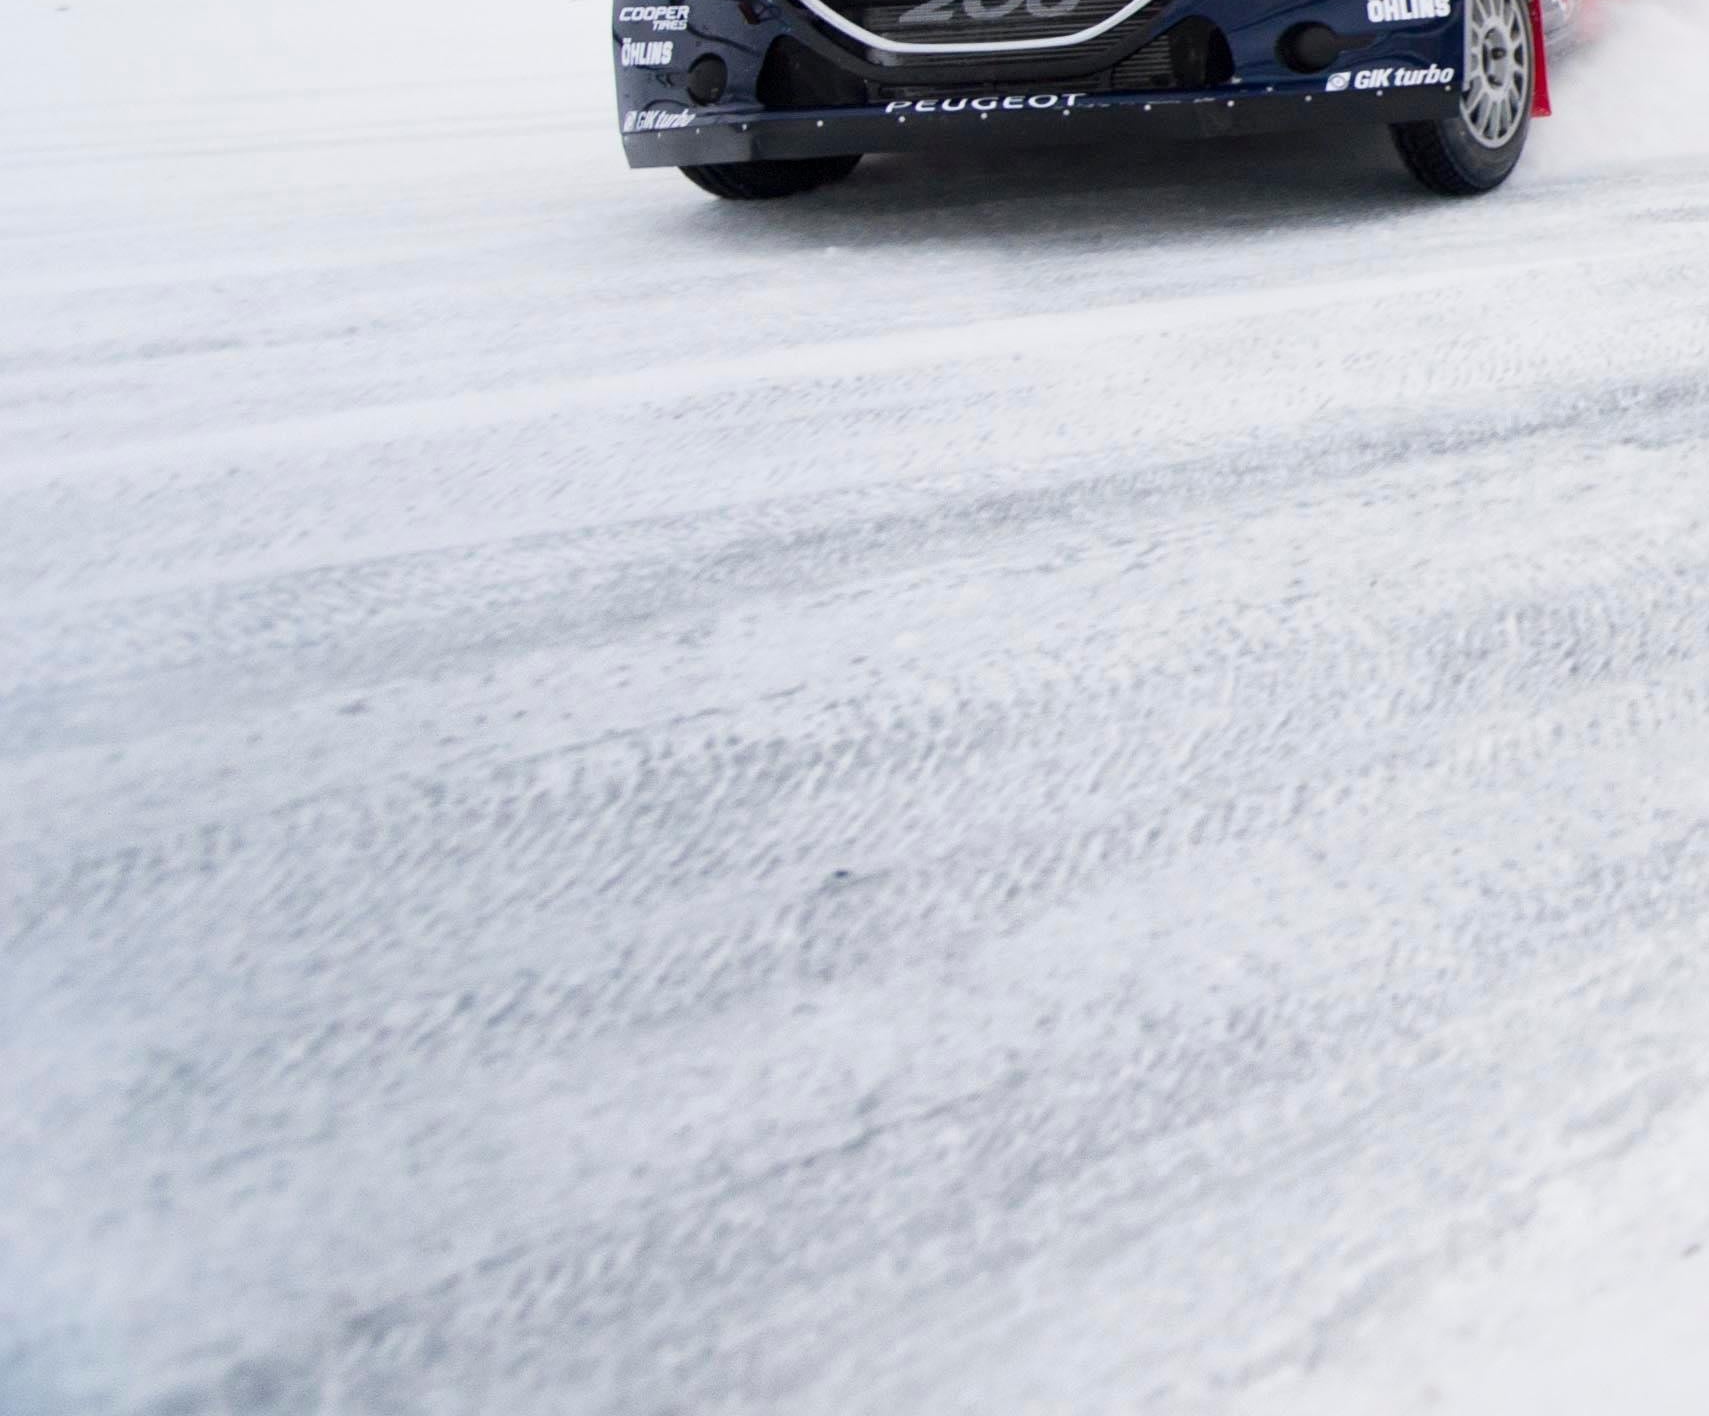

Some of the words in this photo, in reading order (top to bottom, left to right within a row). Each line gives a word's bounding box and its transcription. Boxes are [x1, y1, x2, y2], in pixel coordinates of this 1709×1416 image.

[619, 5, 690, 22] COOPER
[652, 19, 688, 31] TIRES
[621, 37, 673, 67] ÖHLINS
[1354, 69, 1393, 89] GIK
[1394, 64, 1455, 87] turbo
[885, 93, 1086, 113] PEUGEOT
